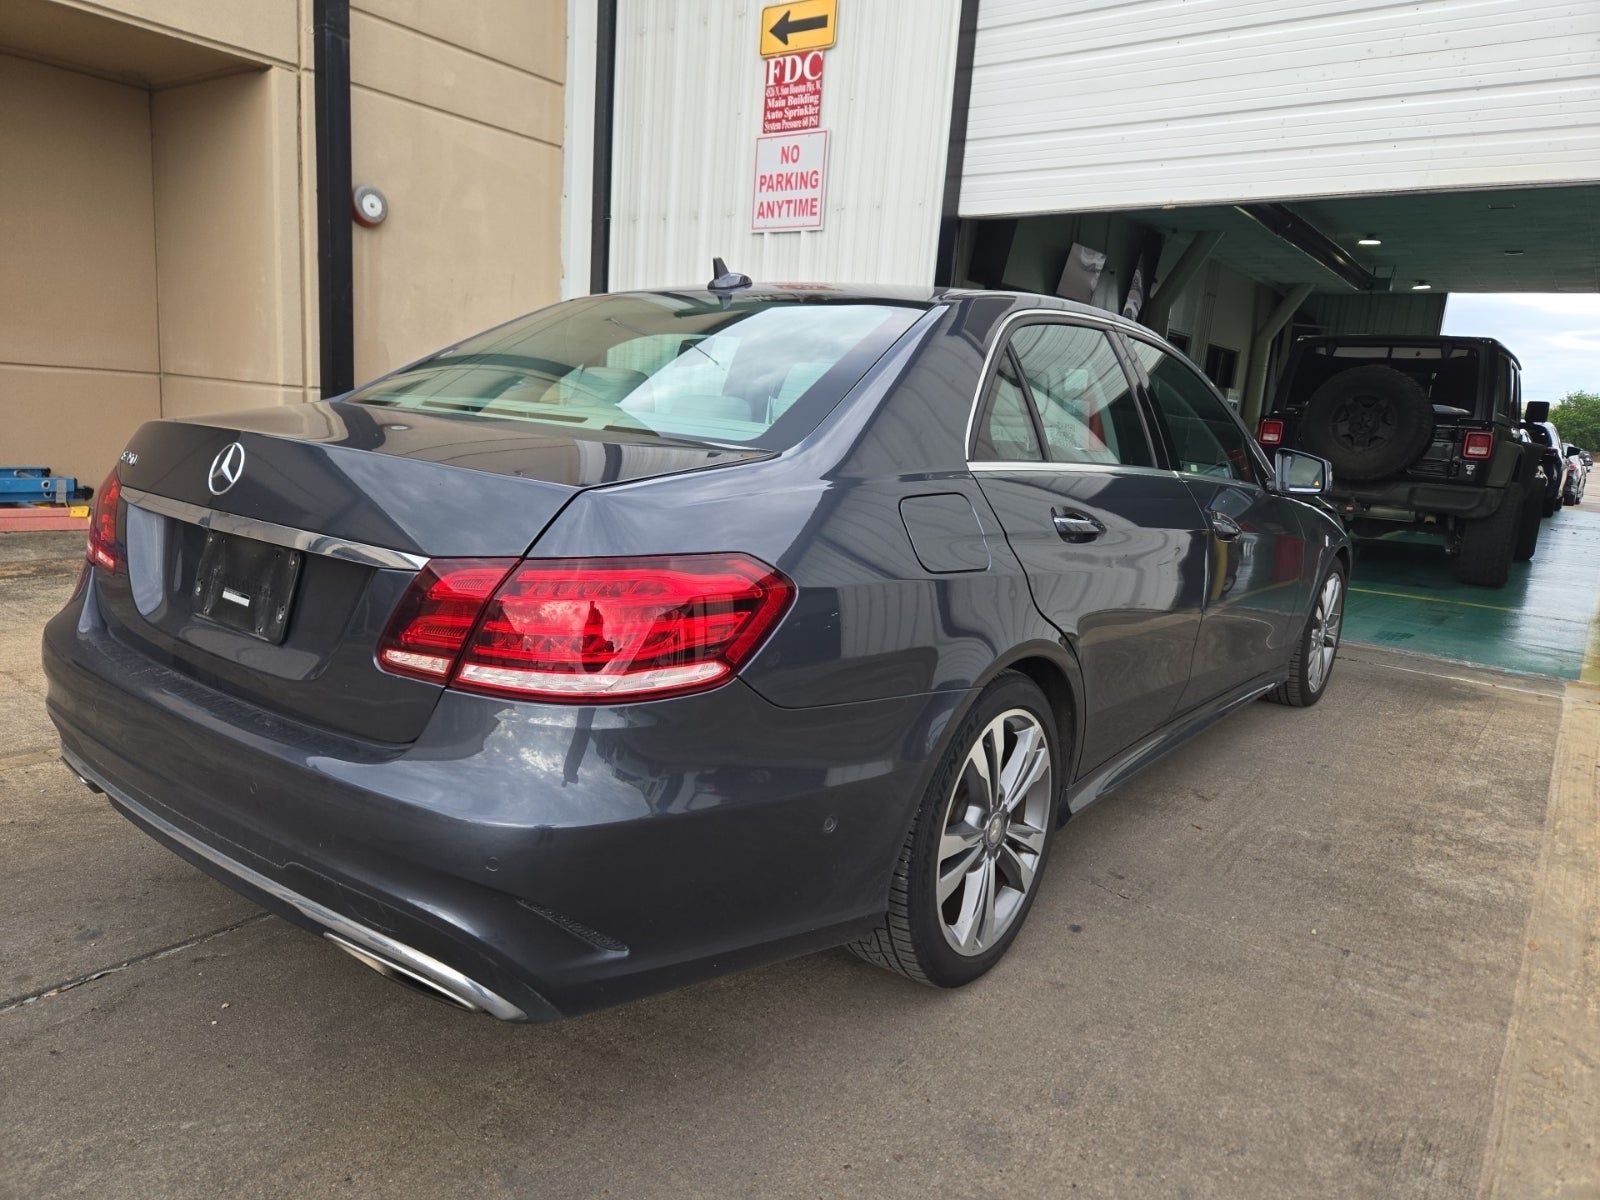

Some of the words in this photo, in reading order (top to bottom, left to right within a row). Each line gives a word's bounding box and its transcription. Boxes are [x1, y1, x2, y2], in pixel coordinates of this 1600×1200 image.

[767, 51, 824, 86] FDC
[767, 98, 786, 108] Main
[788, 94, 819, 106] Building
[765, 110, 783, 120] Auto
[784, 105, 819, 119] Sprinkler
[764, 121, 782, 132] System
[782, 119, 801, 130] Pressure
[780, 144, 800, 165] NO
[759, 170, 819, 193] PARKING
[757, 197, 818, 220] ANYTIME
